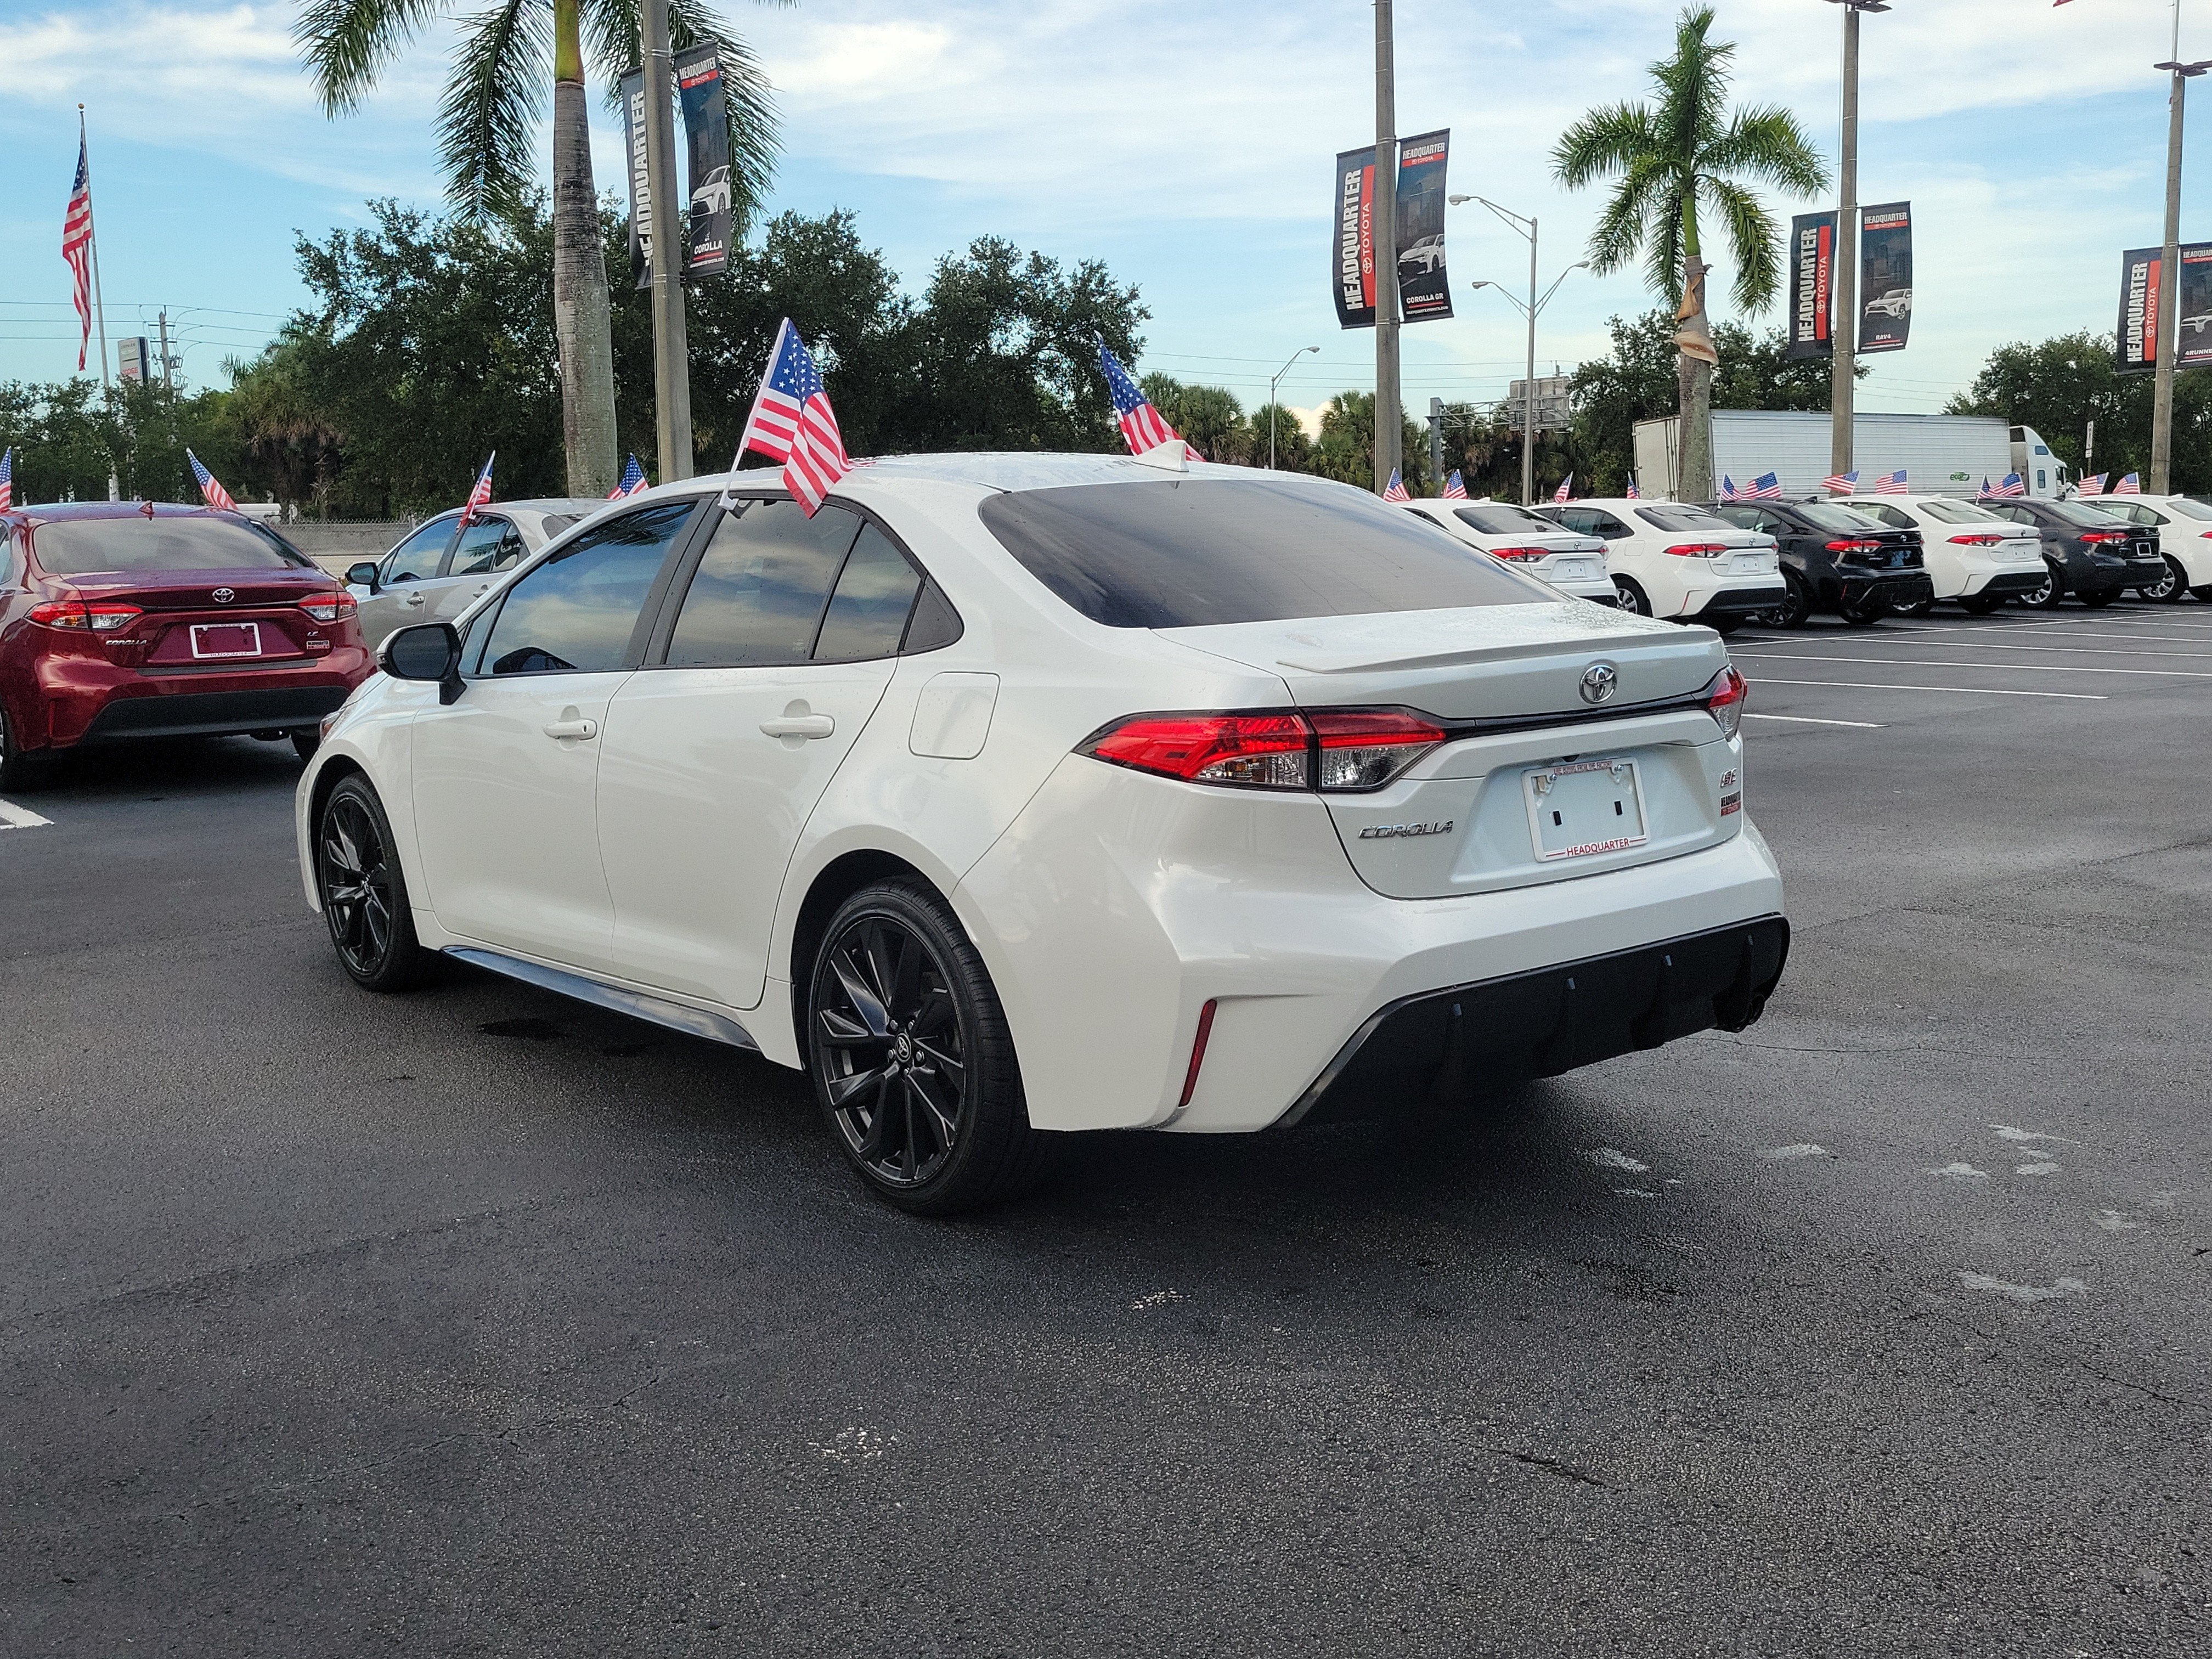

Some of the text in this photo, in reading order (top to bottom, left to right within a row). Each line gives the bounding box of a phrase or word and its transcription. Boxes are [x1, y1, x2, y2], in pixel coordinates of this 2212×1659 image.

[679, 56, 716, 80] HEADQUARTER
[1402, 142, 1445, 160] HEADQUARTER
[1864, 212, 1907, 224] HEADQUARTER
[694, 240, 723, 255] COROLLA
[1342, 169, 1364, 311] HEADQUARTER
[1798, 228, 1818, 342] HEADQUARTER
[1818, 256, 1827, 298] TOYOTA
[1406, 294, 1435, 304] COROLLA
[2147, 287, 2157, 325] TOYOTA
[2127, 262, 2147, 362] HEADQUARTER
[1358, 820, 1454, 838] COROLLA
[1567, 838, 1629, 856] HEADQUARTER
